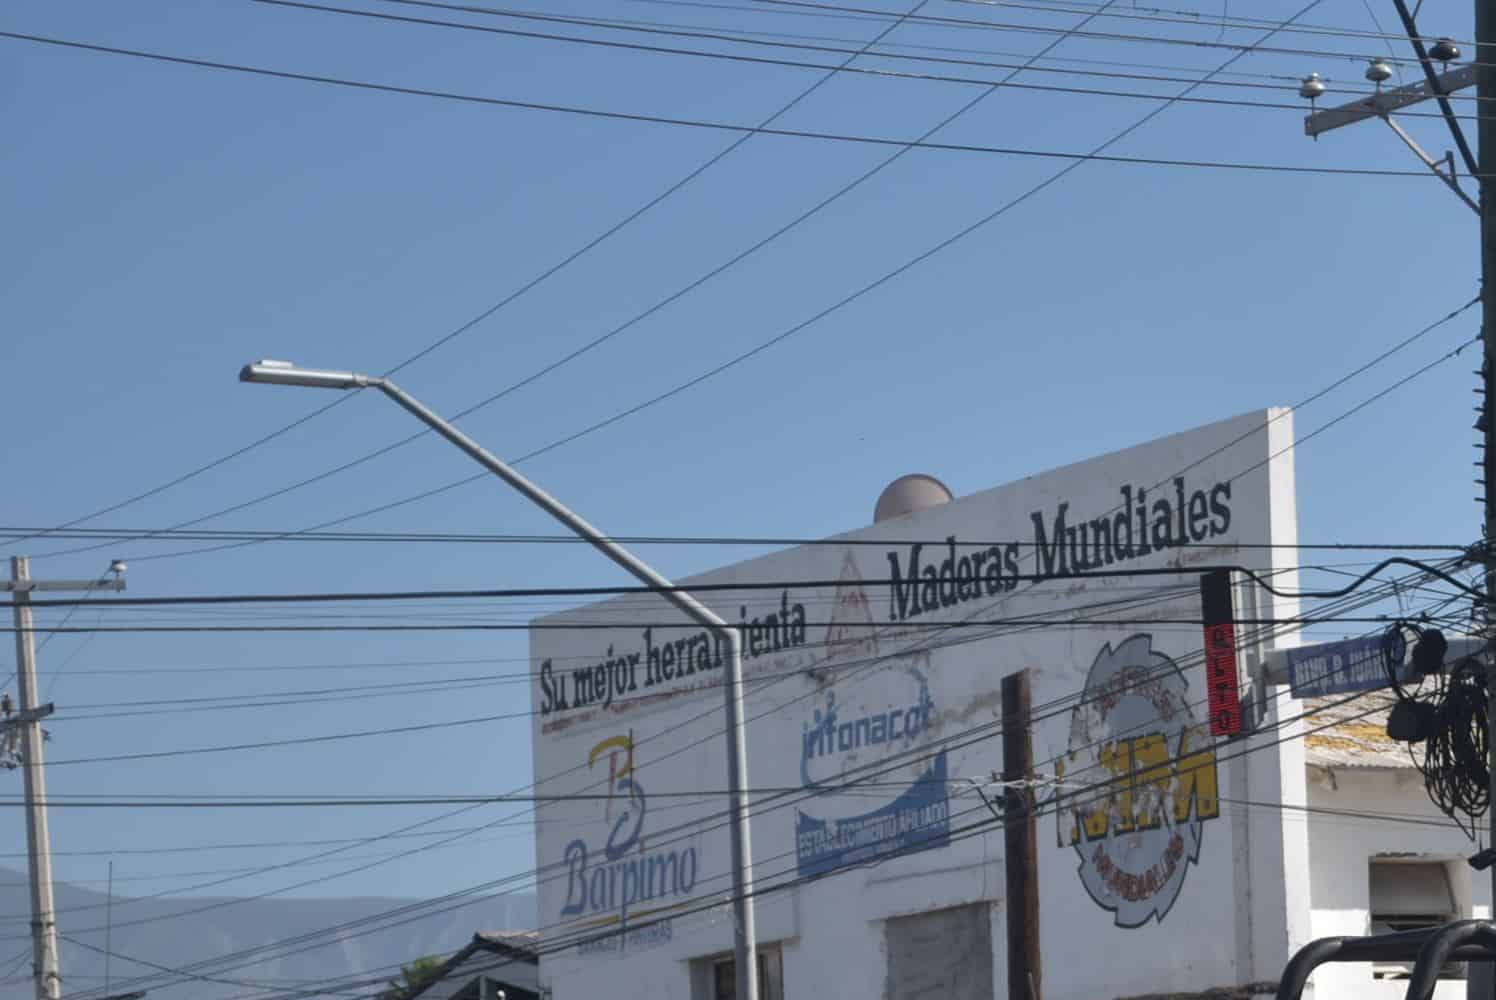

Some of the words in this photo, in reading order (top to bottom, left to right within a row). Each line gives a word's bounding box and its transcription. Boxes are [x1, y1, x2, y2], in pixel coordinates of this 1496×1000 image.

[887, 536, 1021, 622] Maderas
[1029, 475, 1232, 585] Mundiales
[539, 657, 568, 716] Su
[573, 643, 642, 711] mejor
[560, 839, 697, 924] Barpimo
